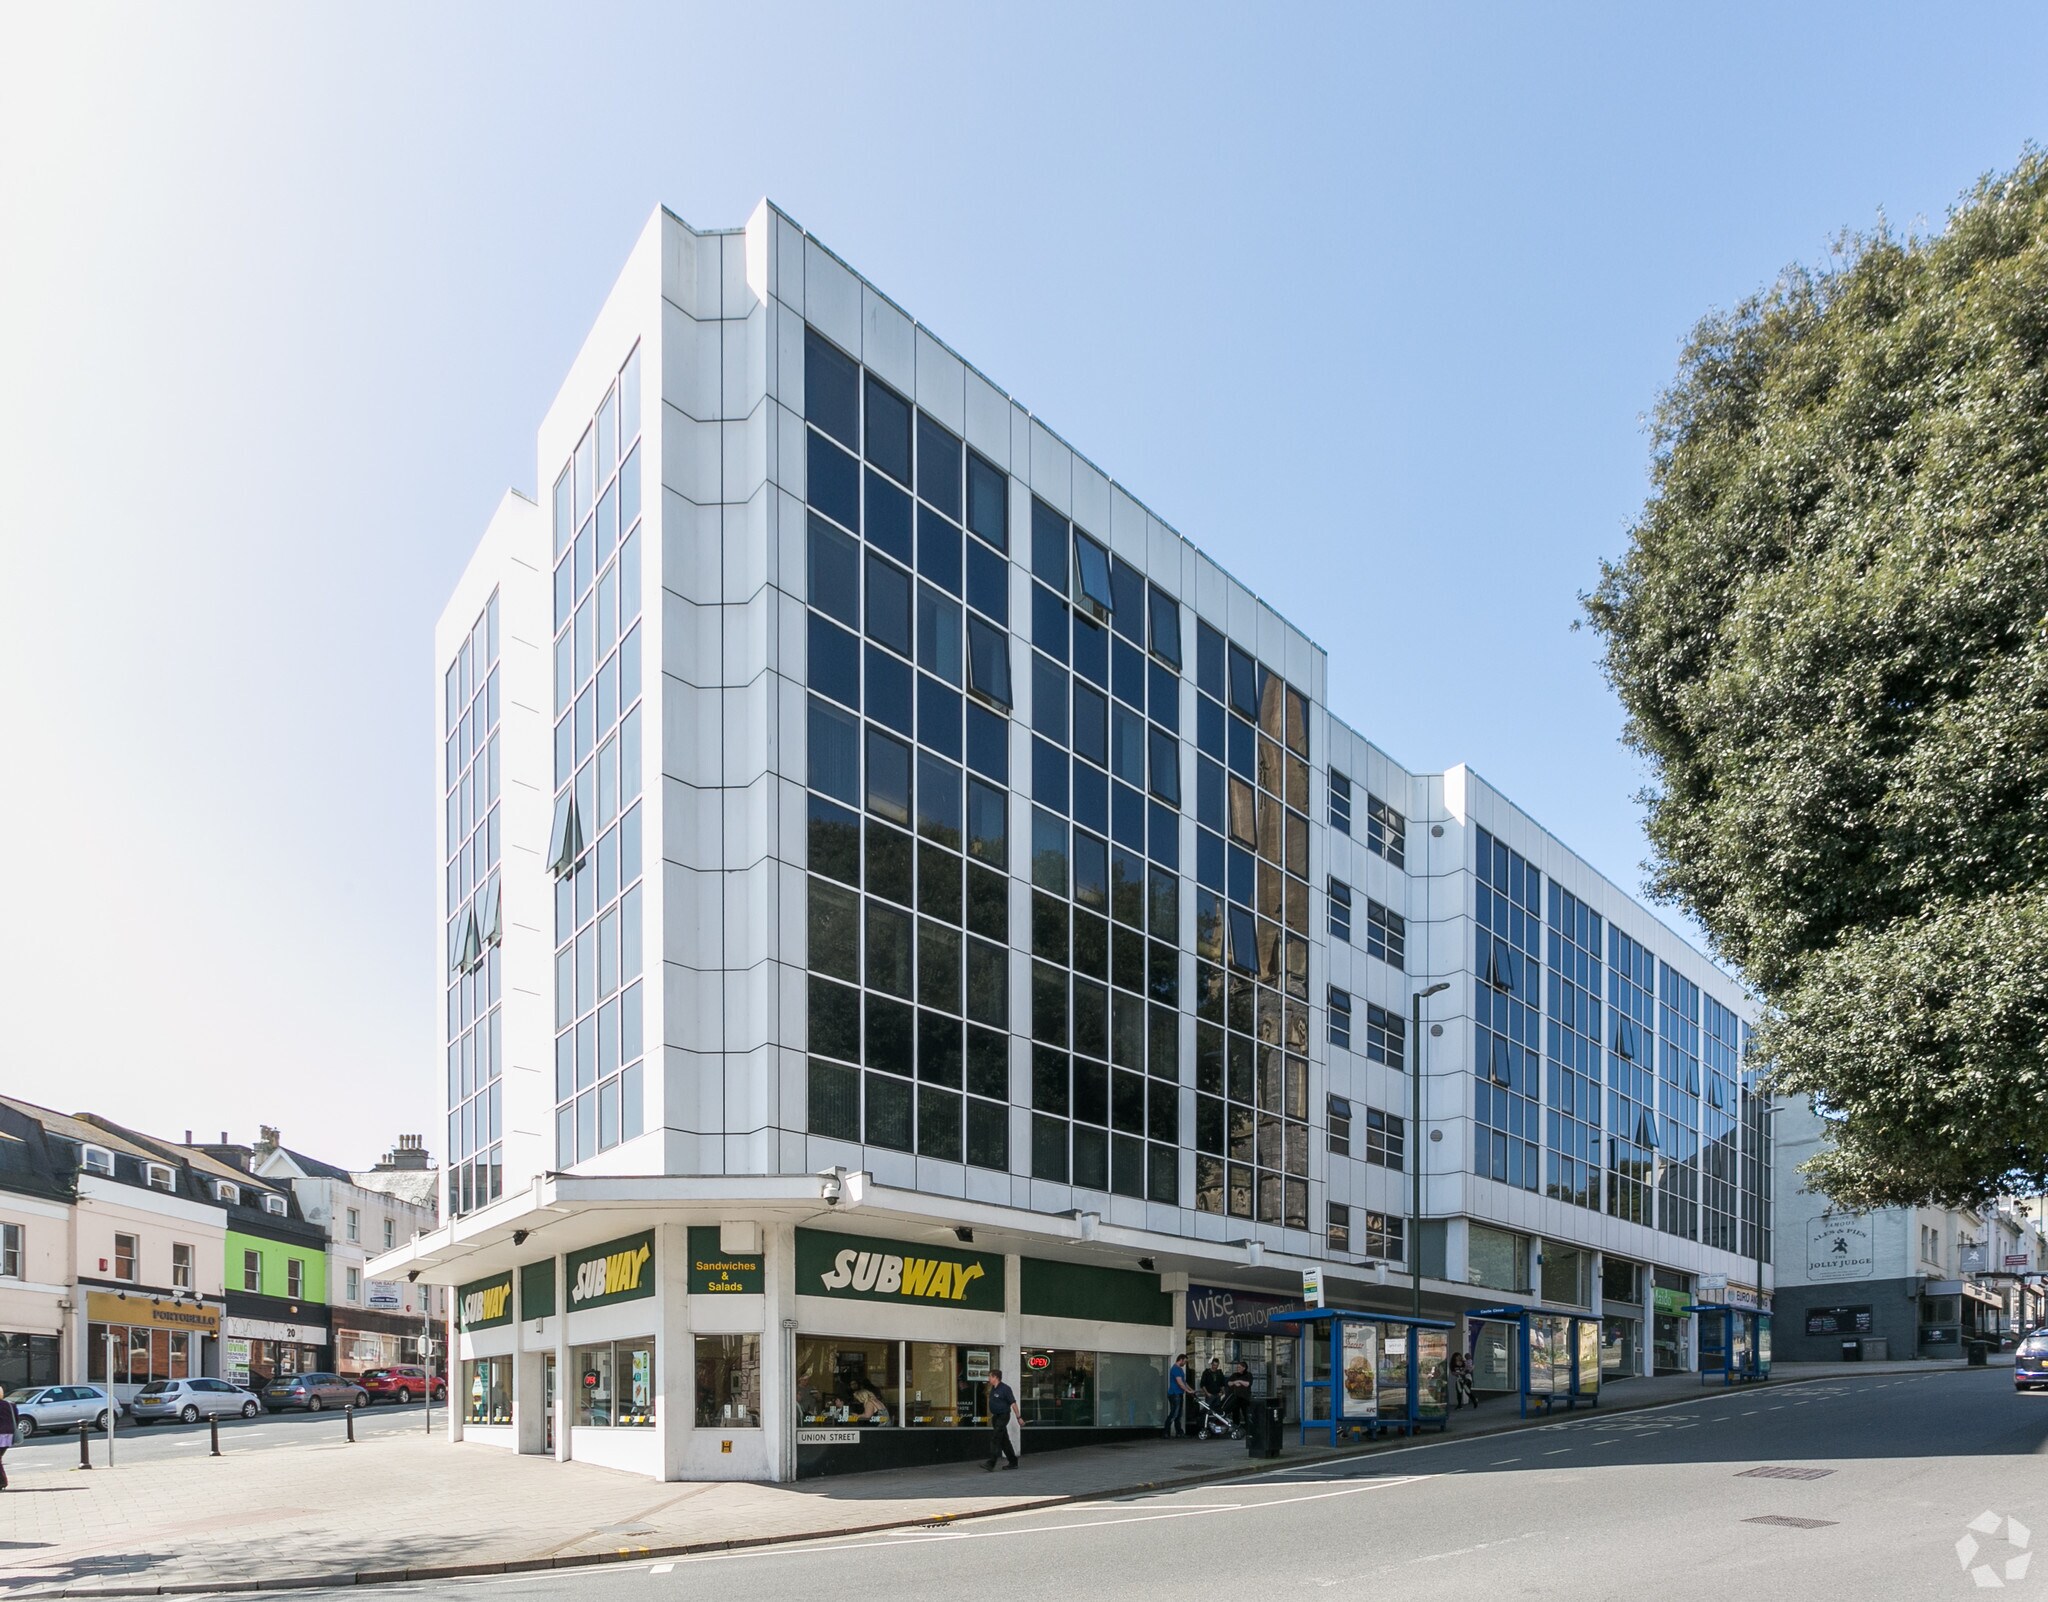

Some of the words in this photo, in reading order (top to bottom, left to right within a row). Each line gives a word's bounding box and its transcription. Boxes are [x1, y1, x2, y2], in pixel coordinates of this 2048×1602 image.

[1825, 1220, 1855, 1228] FAMOUS
[1813, 1229, 1835, 1242] ALES
[1846, 1228, 1867, 1238] PIES
[696, 1261, 756, 1270] Sandwiches
[1809, 1260, 1839, 1270] JOLLY
[1839, 1258, 1872, 1268] JUDGE
[572, 1241, 650, 1304] SUBWAY
[721, 1271, 729, 1280] &
[821, 1249, 985, 1300] SUBWAY
[708, 1281, 743, 1291] Salads
[461, 1280, 511, 1326] SUBWAY
[1737, 1290, 1750, 1303] EURO
[1751, 1293, 1768, 1307] ANNG
[1192, 1289, 1234, 1321] wise
[153, 1310, 215, 1325] PORTOBELLO
[1228, 1301, 1296, 1331] employment
[287, 1328, 296, 1338] 20
[228, 1343, 247, 1353] OVING
[1030, 1357, 1047, 1367] OPEN
[801, 1433, 826, 1441] UNION
[830, 1433, 856, 1441] STREET
